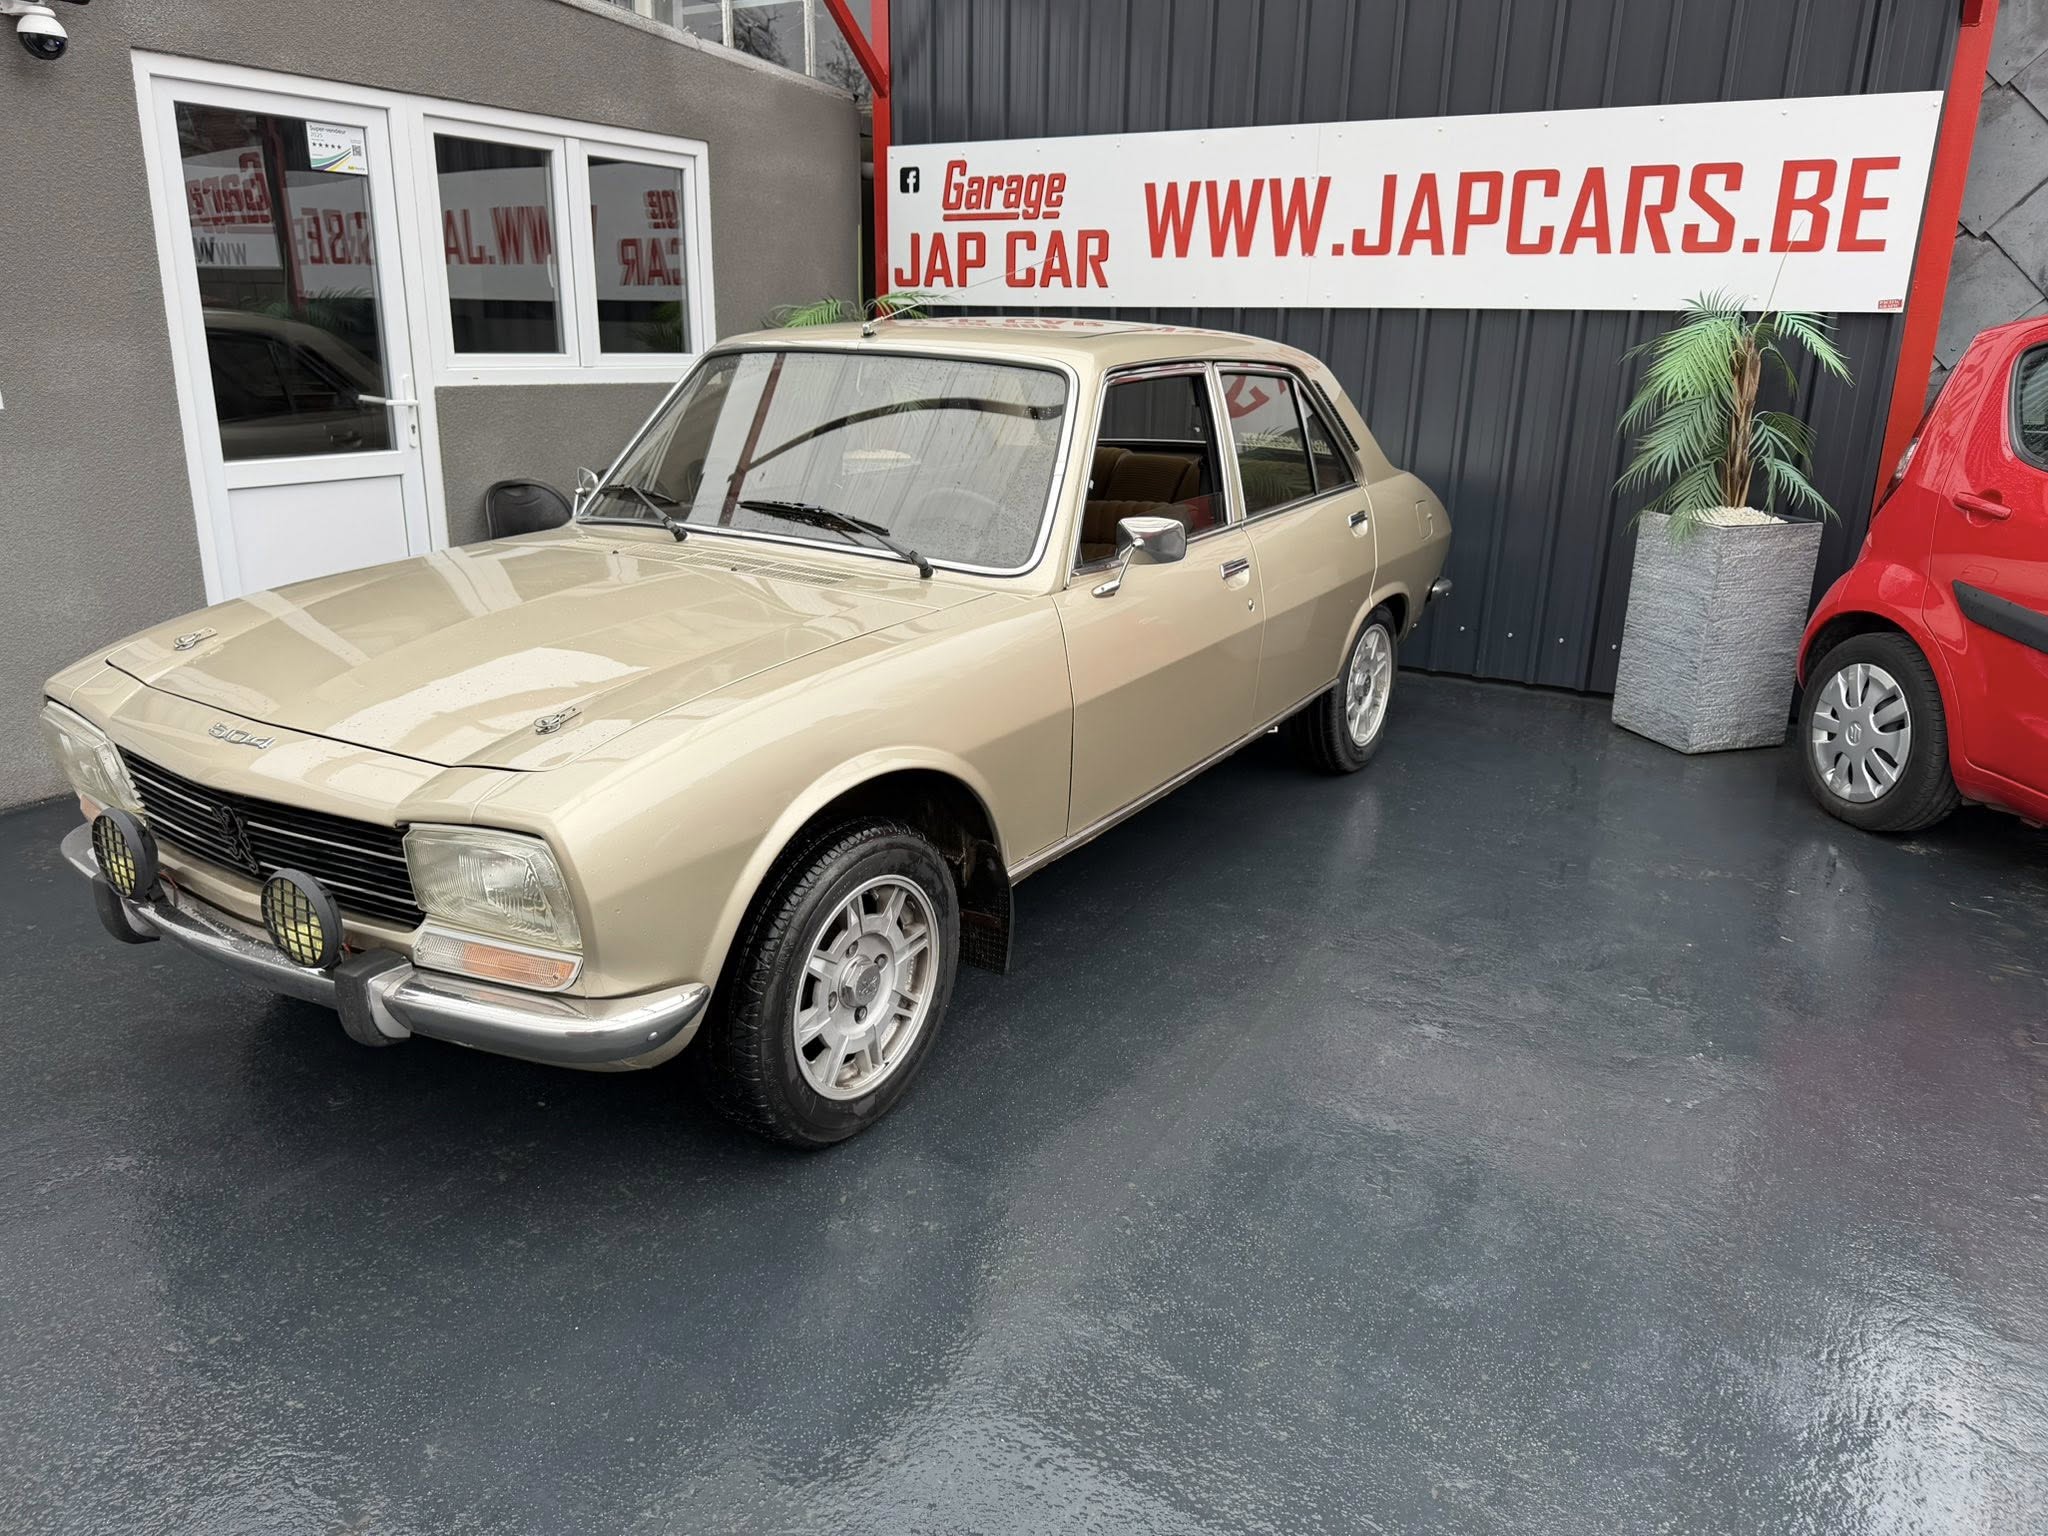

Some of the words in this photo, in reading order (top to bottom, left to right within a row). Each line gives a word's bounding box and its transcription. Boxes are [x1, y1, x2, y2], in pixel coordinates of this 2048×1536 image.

[943, 160, 1068, 221] Garage
[1145, 157, 1900, 258] WWW.JAPCARS.BE
[894, 231, 987, 288] JAP
[1006, 230, 1110, 288] CAR
[208, 722, 275, 749] 504
